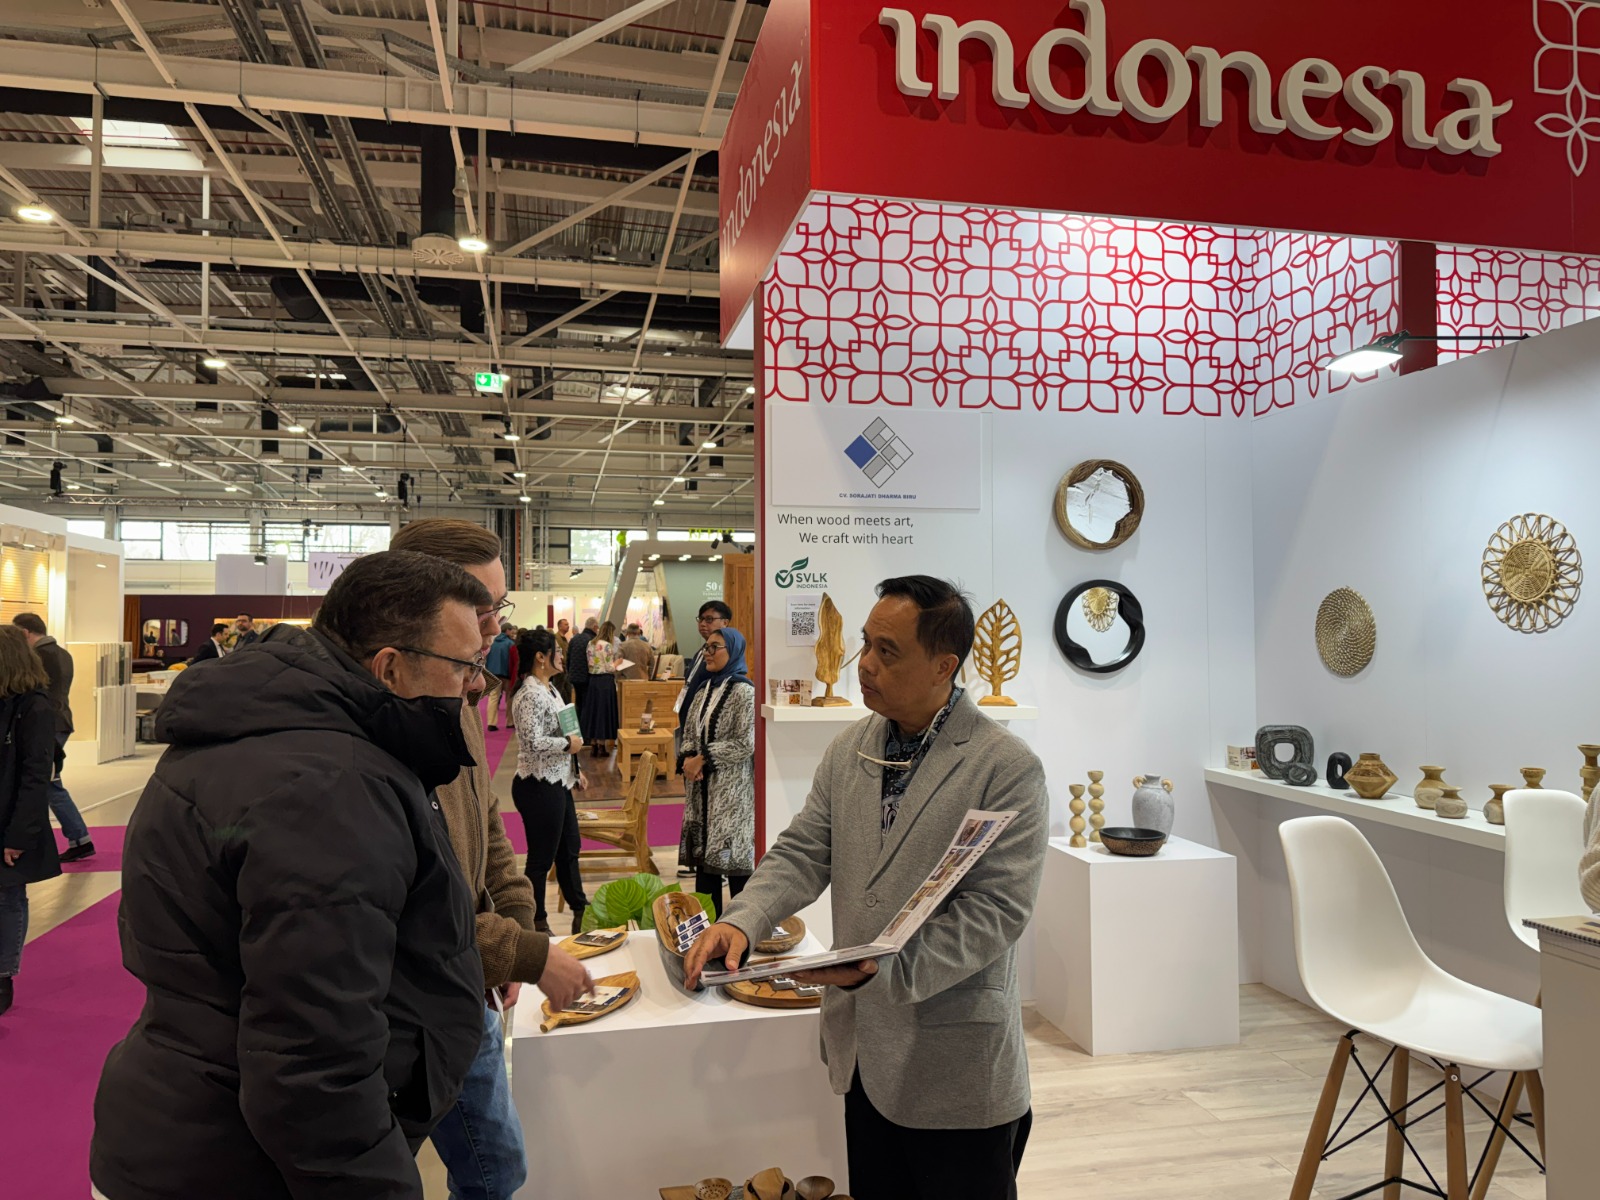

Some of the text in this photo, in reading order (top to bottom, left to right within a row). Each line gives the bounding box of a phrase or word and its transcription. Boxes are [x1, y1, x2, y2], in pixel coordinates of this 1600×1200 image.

[777, 513, 913, 528] When wood meets art,
[799, 532, 914, 545] We craft with heart
[795, 572, 828, 583] SVLK
